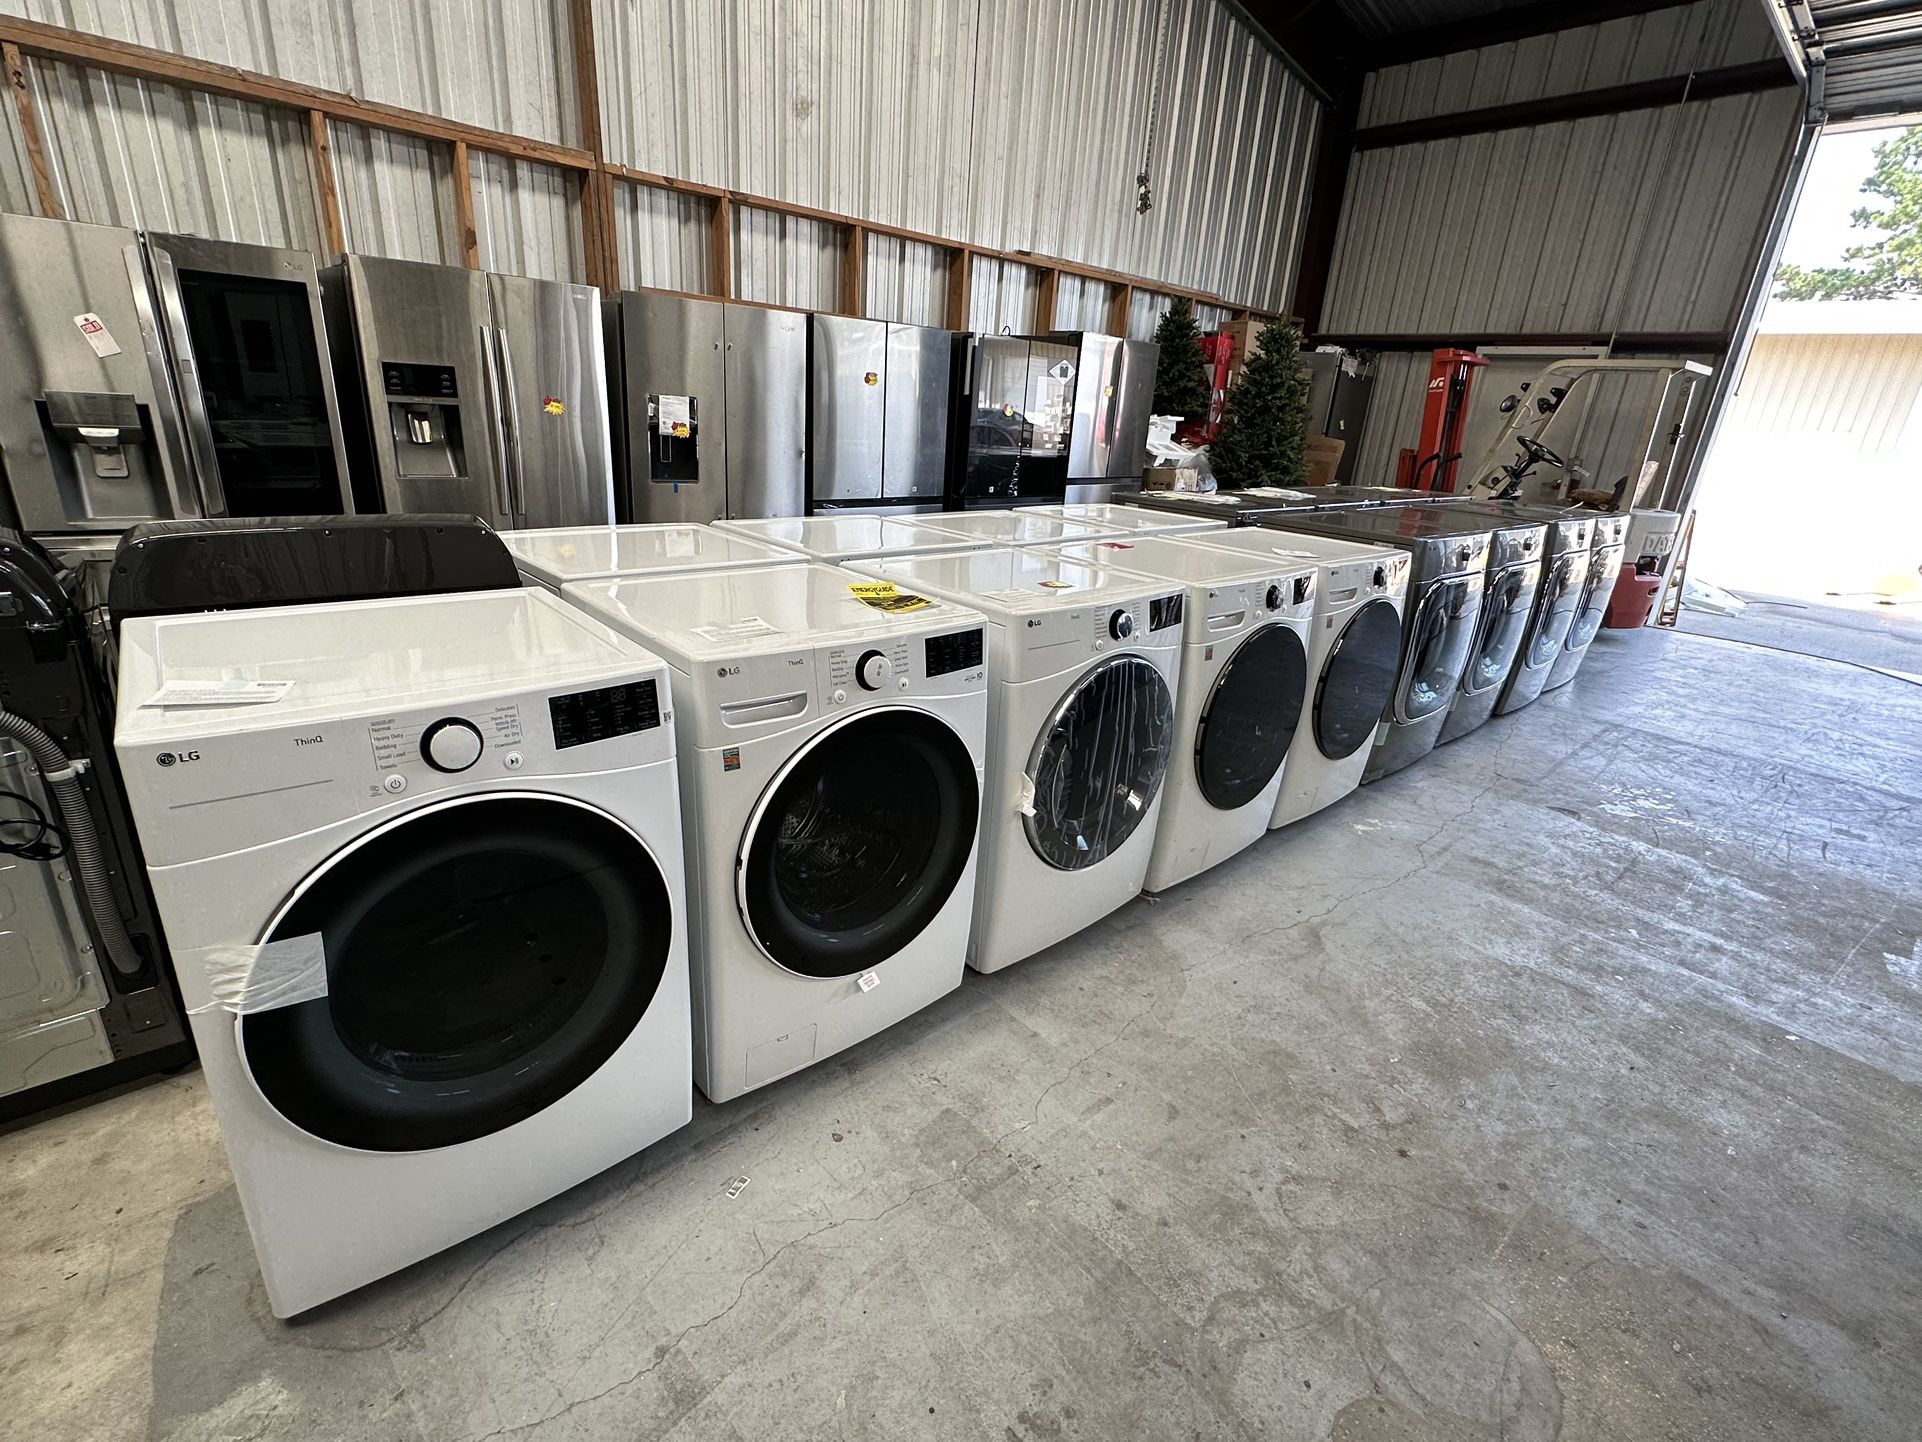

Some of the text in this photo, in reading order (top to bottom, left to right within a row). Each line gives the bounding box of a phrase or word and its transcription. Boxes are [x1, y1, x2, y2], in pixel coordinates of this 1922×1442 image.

[787, 658, 804, 667] ThinQ
[728, 666, 741, 676] LG
[371, 725, 392, 733] Normal
[293, 735, 324, 747] ThinQ
[375, 743, 397, 751] Bedding
[178, 750, 201, 763] LG
